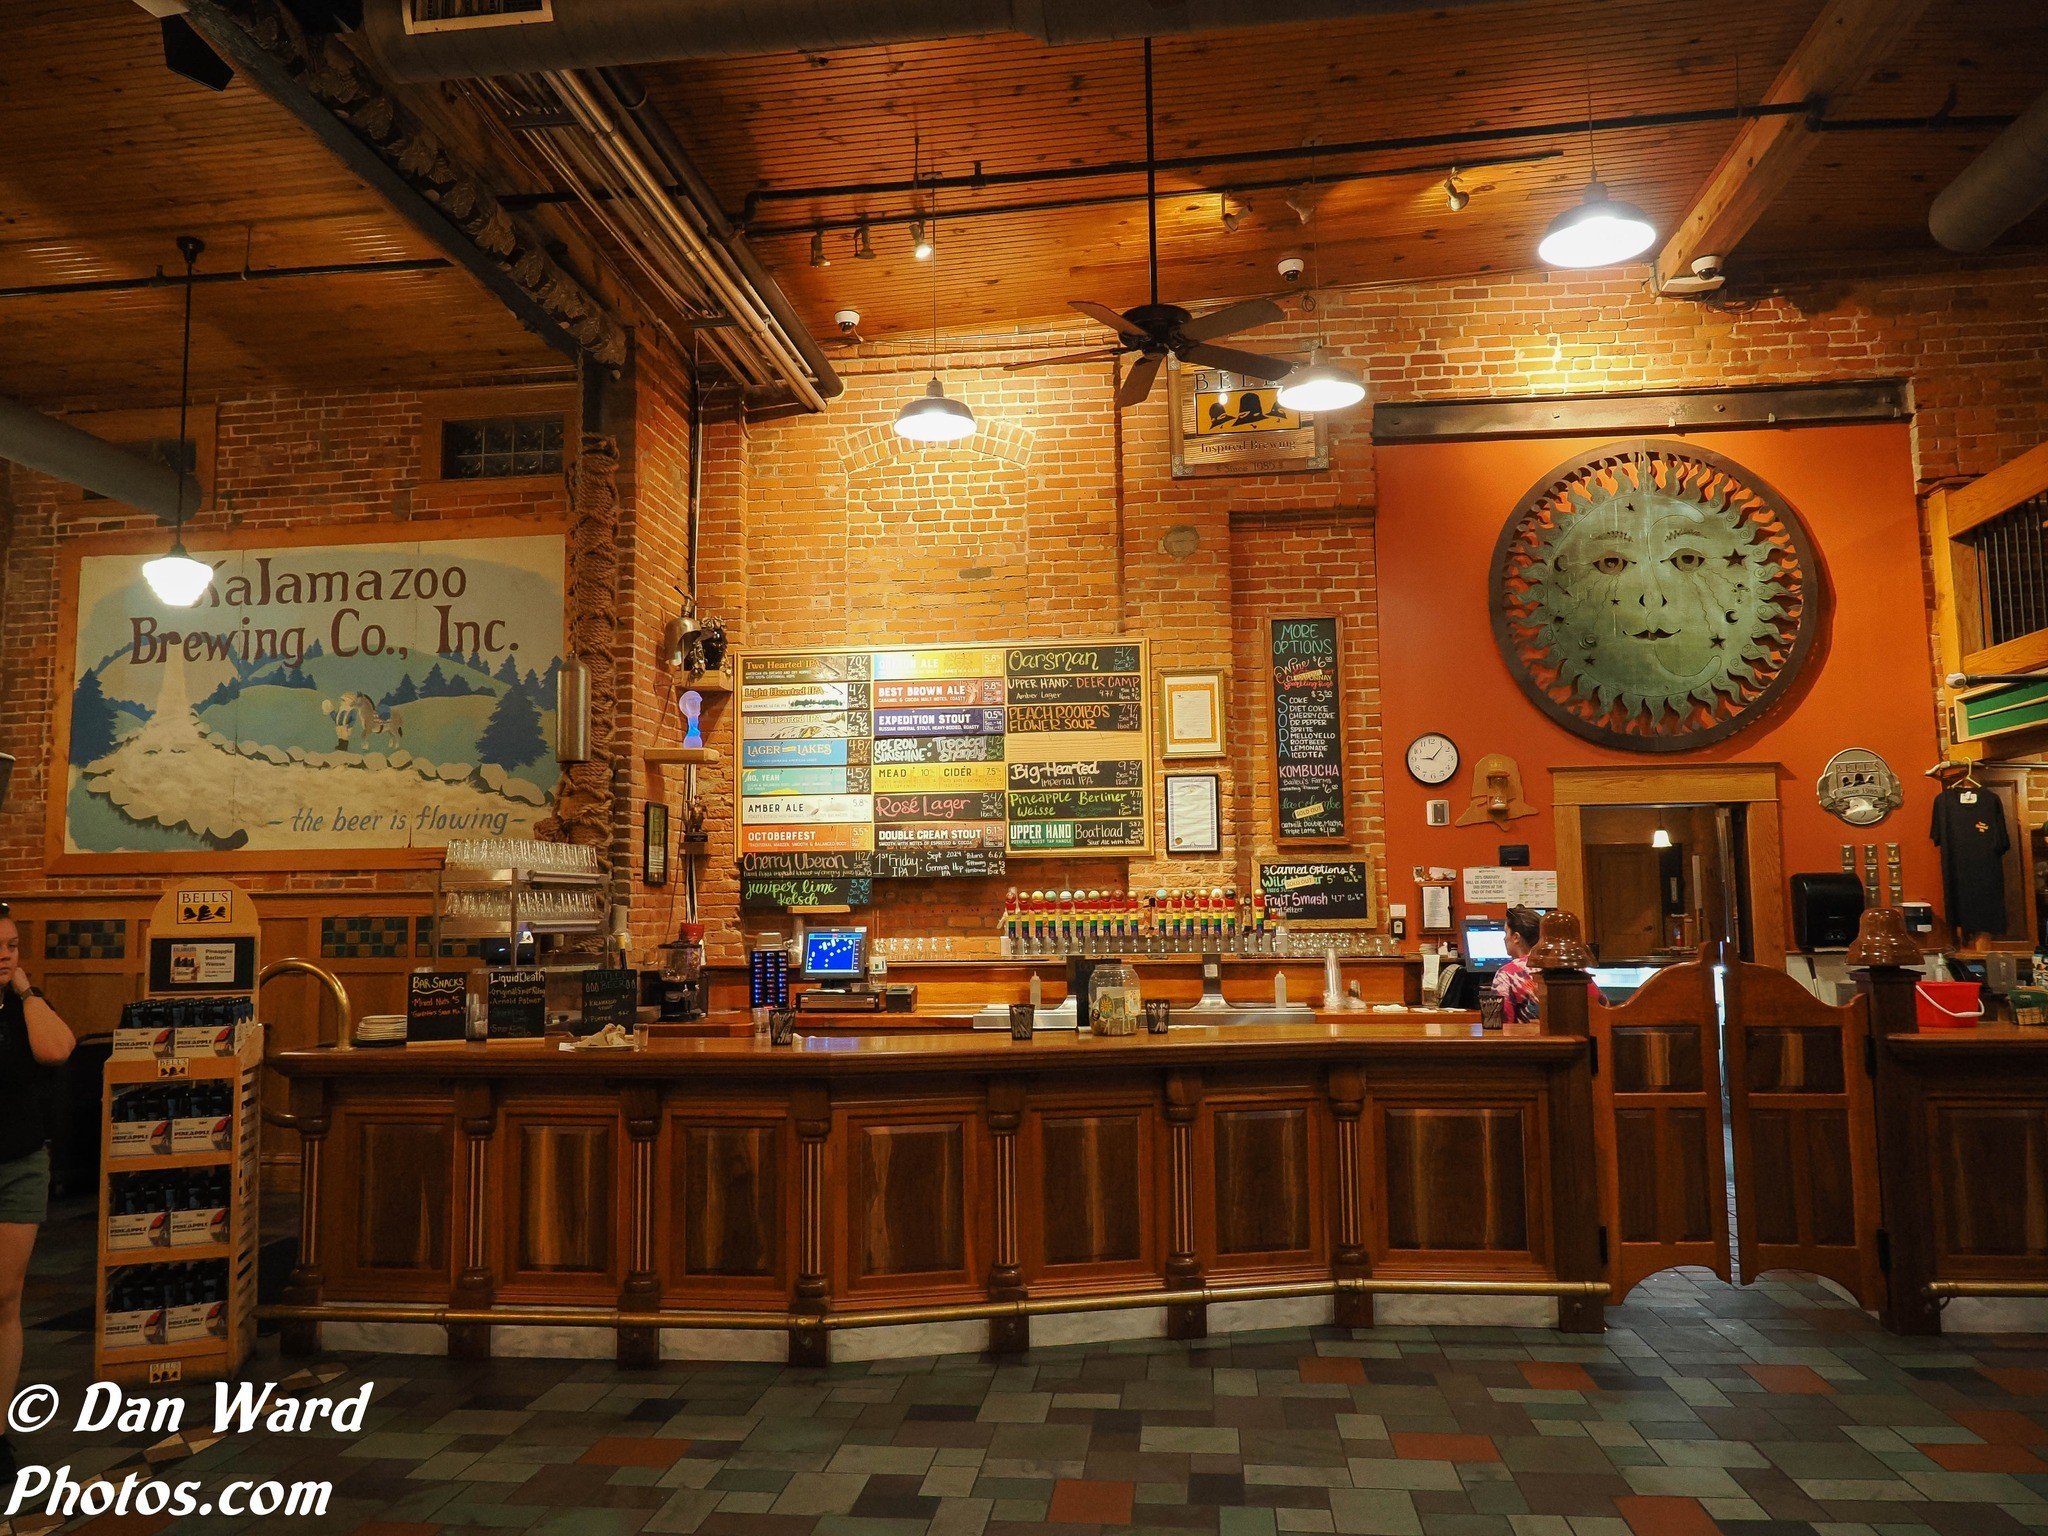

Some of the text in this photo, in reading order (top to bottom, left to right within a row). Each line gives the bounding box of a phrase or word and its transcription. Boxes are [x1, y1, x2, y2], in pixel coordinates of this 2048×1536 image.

[1201, 438, 1296, 455] Inspired Brewing
[130, 604, 519, 669] Brewing Co., Inc.
[1280, 623, 1319, 641] MORE
[1273, 638, 1333, 655] OPTIONS
[745, 659, 821, 670] Two Hearted IPA
[1008, 649, 1100, 672] Oarsman
[1274, 657, 1310, 676] Wine
[1007, 678, 1039, 690] UPPER
[1075, 677, 1106, 689] DEER
[1107, 676, 1140, 688] CAMP
[744, 687, 768, 699] Light
[769, 685, 806, 697] Hearted
[878, 685, 966, 698] BEST BROWN ALE
[1015, 691, 1063, 701] Amber Lager
[1288, 696, 1309, 704] COKE
[1007, 704, 1111, 721] PEACH ROOIBOS
[1288, 711, 1336, 720] CHERRY COKE
[1289, 704, 1329, 713] DIET COKE
[747, 715, 768, 727] Hazy
[770, 714, 804, 724] Hearted
[878, 713, 972, 726] EXPEDITION STOUT
[1009, 718, 1098, 733] FLOWER SOUR
[1289, 719, 1301, 727] DR
[747, 744, 781, 757] LAGER
[796, 743, 833, 756] LAKES
[874, 735, 987, 751] OBERON Tropical
[1290, 744, 1329, 752] LEMONADE
[874, 748, 927, 764] SUNSHINE
[938, 746, 988, 762] Shandy
[1291, 751, 1325, 759] ICED TEA
[761, 773, 780, 782] YEAH
[878, 768, 907, 778] MEAD
[943, 767, 972, 778] CIDER
[1278, 764, 1340, 778] KOMBUCHA
[1040, 775, 1095, 788] Imperial IPA
[1009, 790, 1128, 807] Pineapple Berliner
[748, 803, 804, 813] AMBER ALE
[875, 795, 971, 819] Rosé Lager
[1016, 805, 1057, 817] Weisse
[1296, 808, 1311, 817] SOLD
[1310, 805, 1323, 814] OUT
[290, 804, 510, 836] the beer is flowing
[747, 830, 817, 841] OCTOBERFEST
[878, 828, 982, 841] DOUBLE CREAM STOUT
[1010, 823, 1073, 840] UPPER HAND
[1074, 822, 1124, 840] Boatload
[743, 852, 849, 874] Cherry Uberon
[891, 866, 909, 878] IPA
[952, 861, 965, 874] Hop
[1269, 864, 1348, 876] Canned Options
[1262, 874, 1286, 888] Wild
[745, 879, 838, 900] juniper lime
[181, 891, 229, 904] BELL'S
[1263, 892, 1329, 907] Fruit Smash
[1282, 906, 1304, 914] Seltzer
[412, 975, 466, 990] BAR SNACKS
[489, 969, 546, 988] Liquid Death
